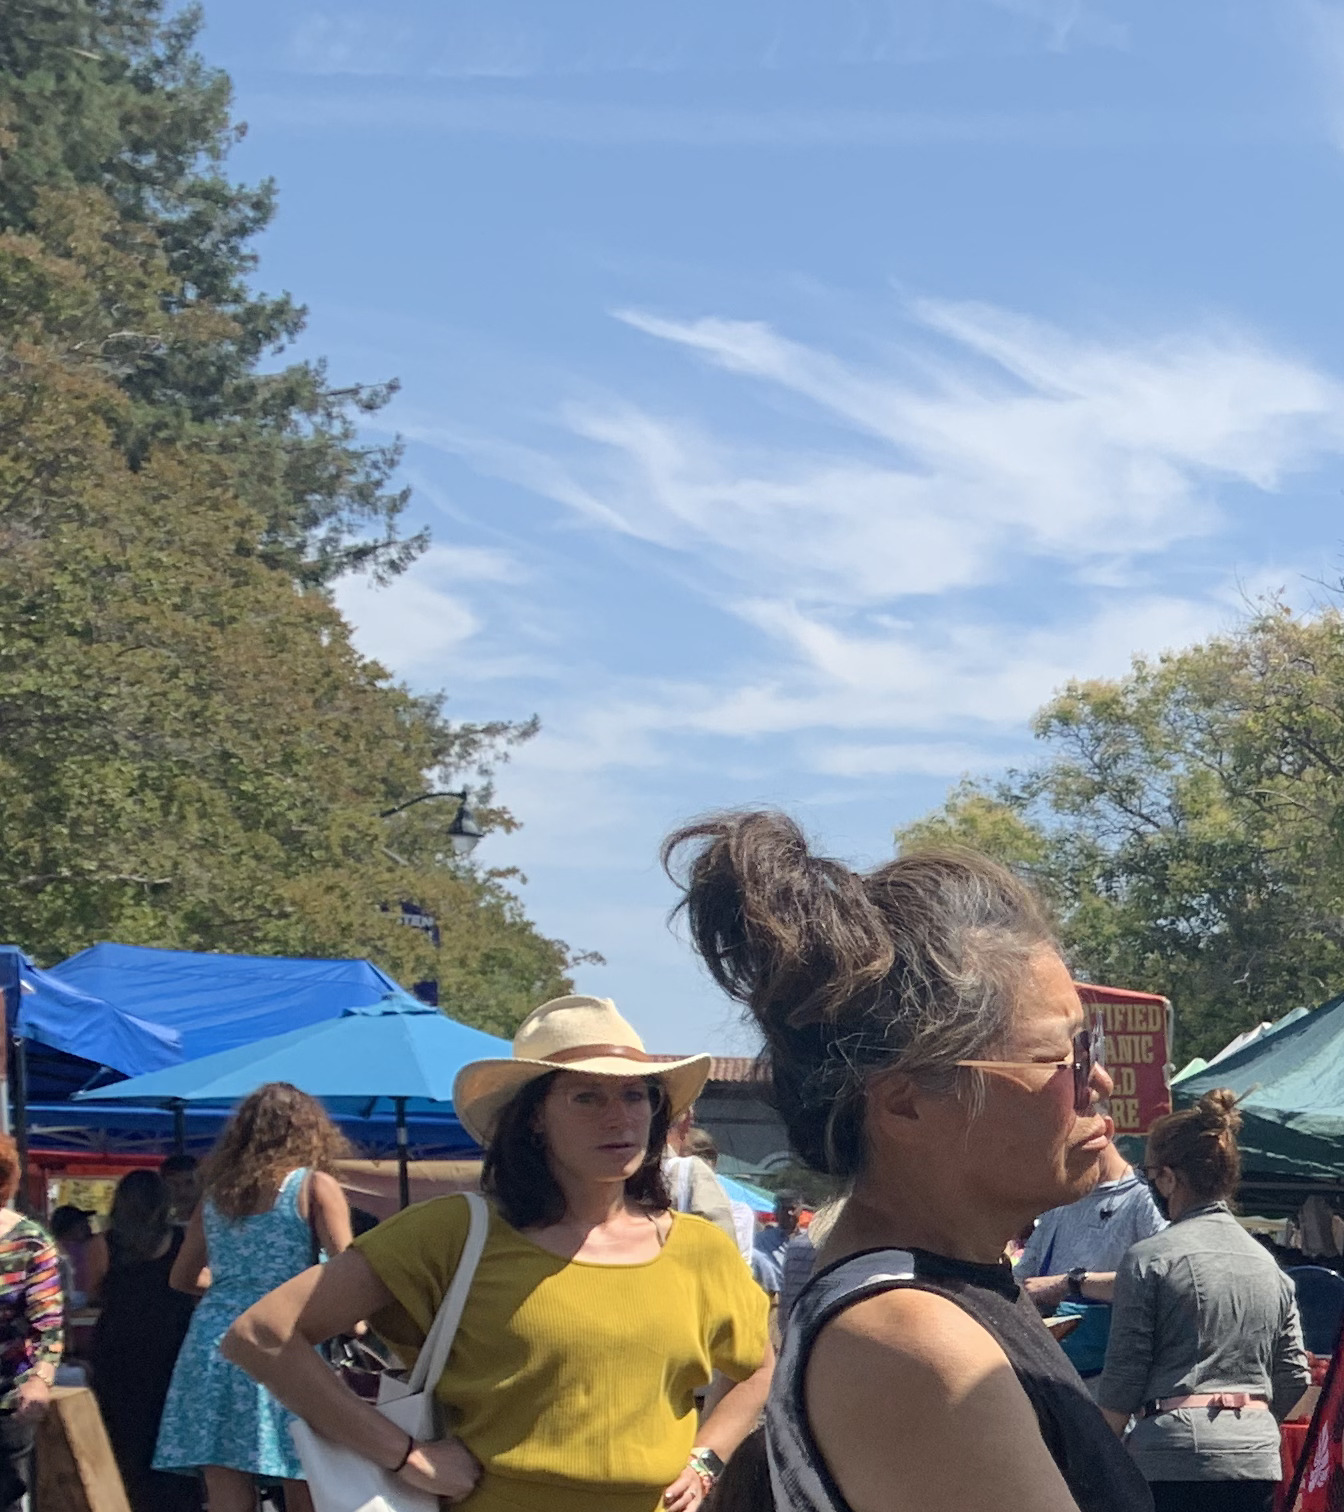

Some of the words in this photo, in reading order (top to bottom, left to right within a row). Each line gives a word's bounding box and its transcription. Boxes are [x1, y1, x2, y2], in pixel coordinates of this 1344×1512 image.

[1083, 1003, 1161, 1032] TIFIED
[1105, 1034, 1154, 1064] ANIC
[1110, 1067, 1137, 1096] LD
[1111, 1098, 1140, 1128] RE
